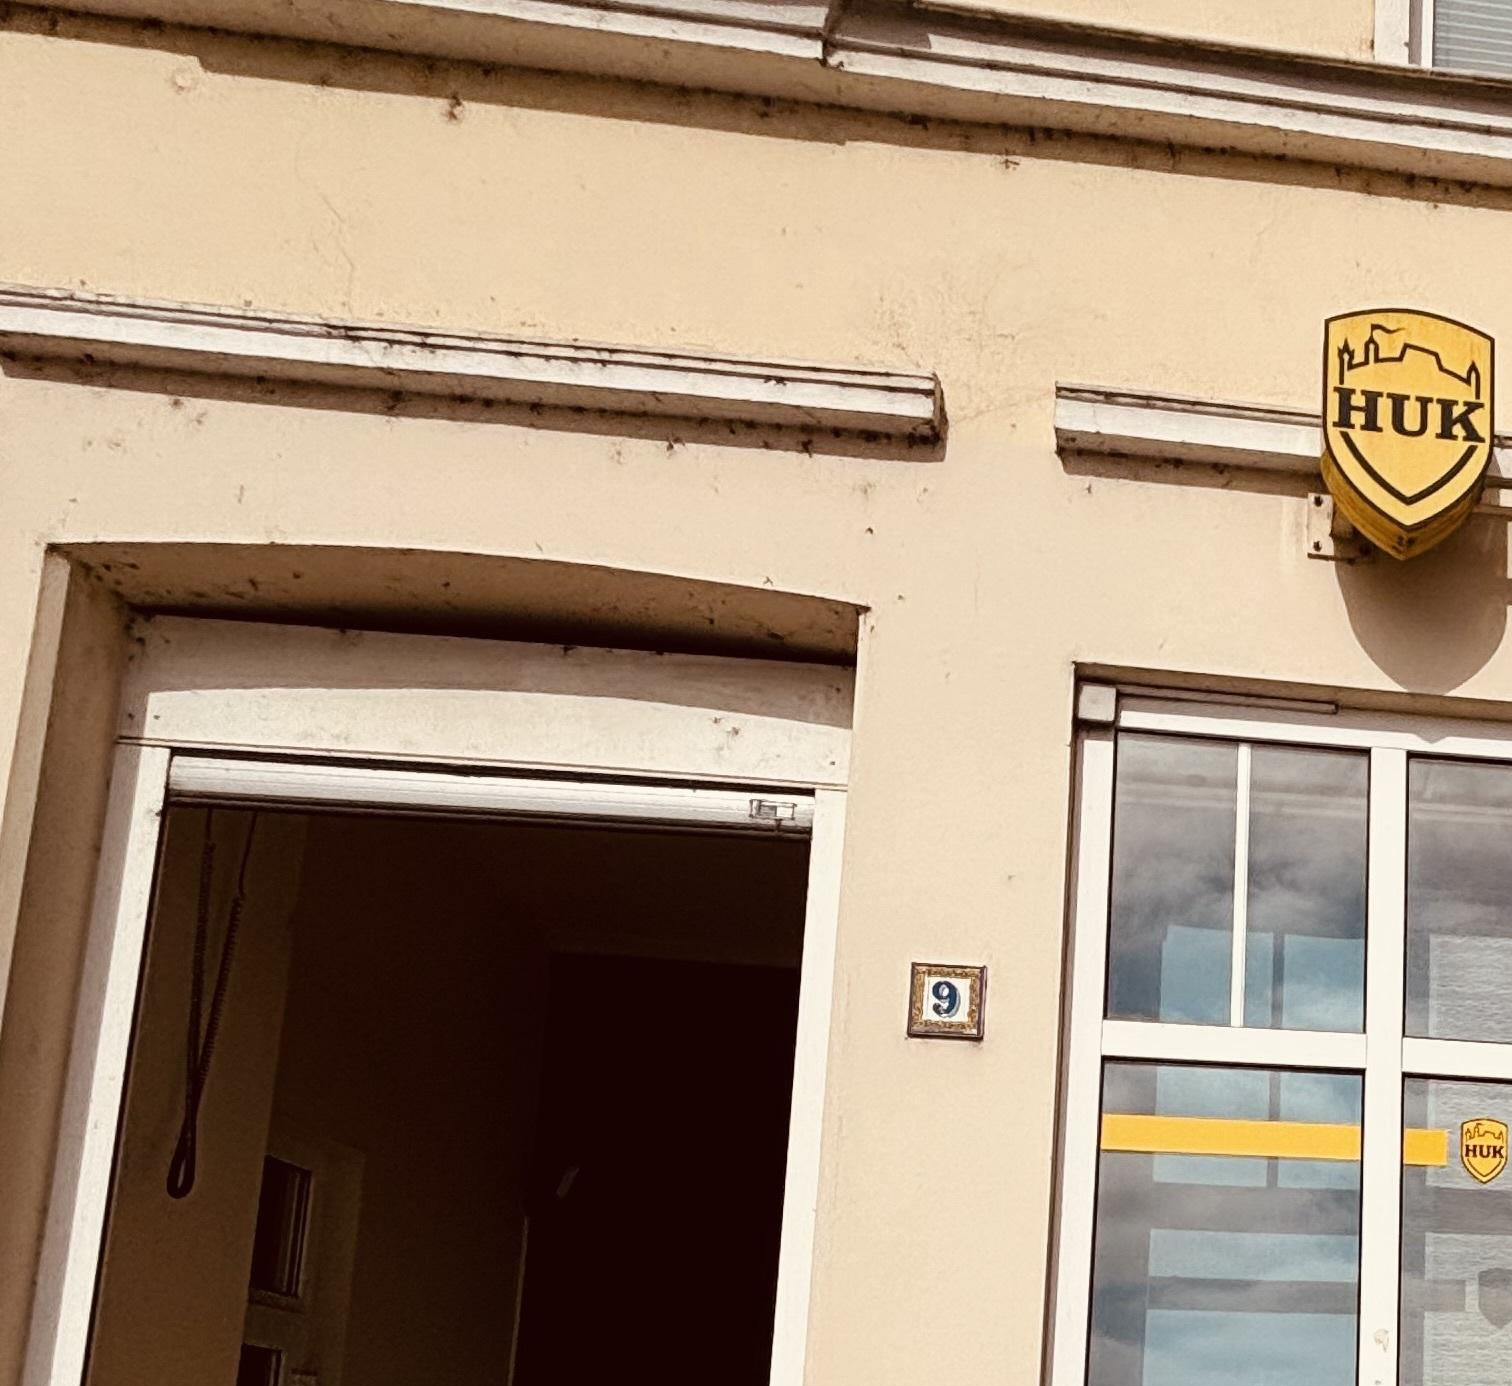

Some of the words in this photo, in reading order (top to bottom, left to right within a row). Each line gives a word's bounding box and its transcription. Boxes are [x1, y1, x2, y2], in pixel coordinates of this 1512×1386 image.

[1332, 386, 1486, 444] HUK
[931, 980, 961, 1018] 9
[1464, 1143, 1505, 1159] HUK
